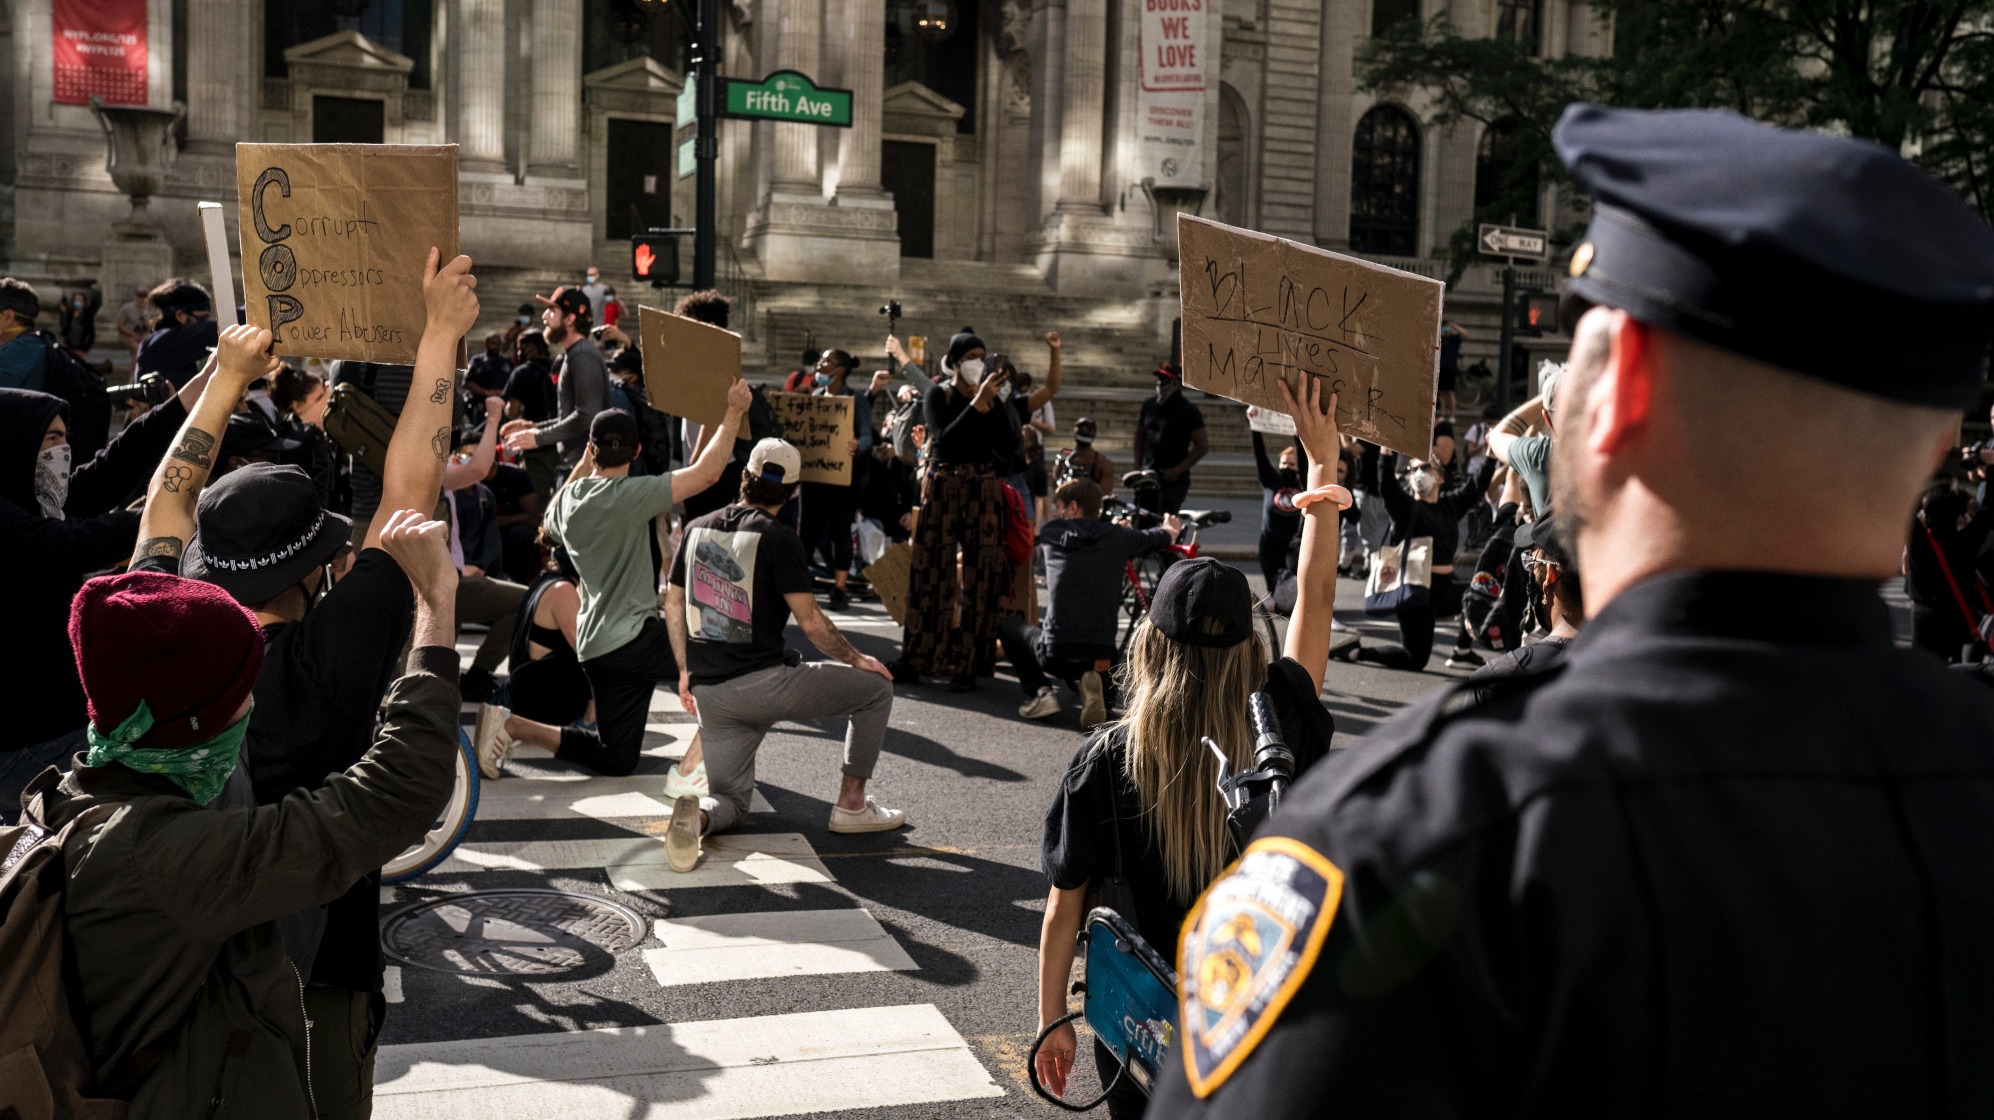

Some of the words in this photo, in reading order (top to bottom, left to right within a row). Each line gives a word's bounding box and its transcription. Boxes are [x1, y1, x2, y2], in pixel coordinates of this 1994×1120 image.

[1146, 0, 1201, 12] BOOKS
[1160, 17, 1189, 40] WE
[1157, 44, 1196, 68] LOVE
[746, 90, 790, 113] Fifth
[795, 96, 832, 117] Ave
[1490, 233, 1509, 248] ONE
[266, 294, 333, 343] Power
